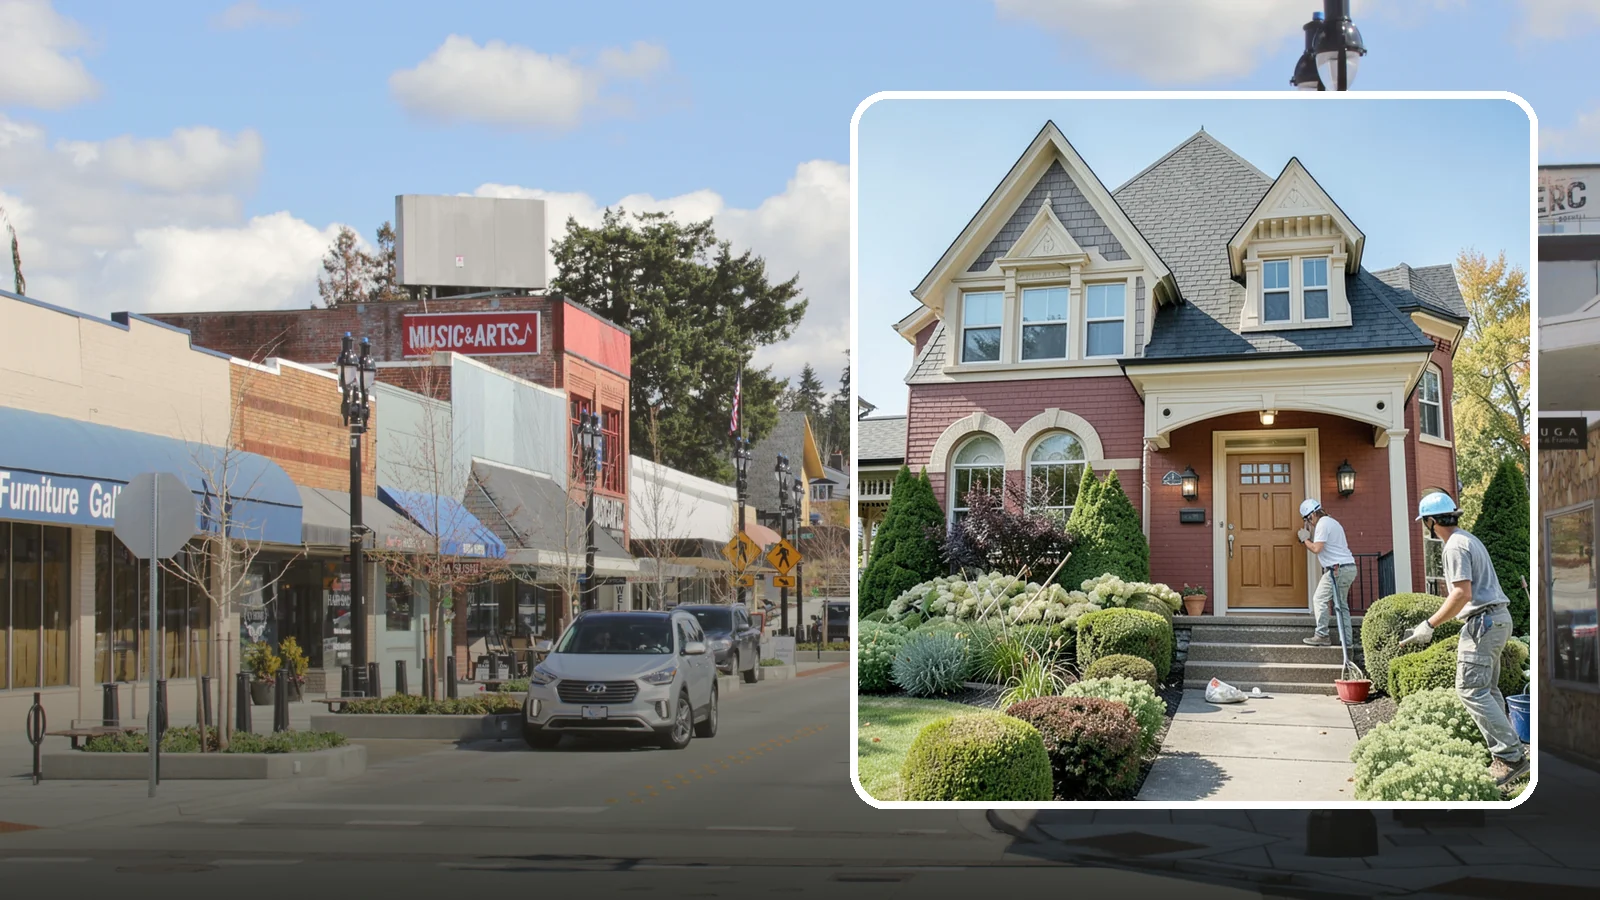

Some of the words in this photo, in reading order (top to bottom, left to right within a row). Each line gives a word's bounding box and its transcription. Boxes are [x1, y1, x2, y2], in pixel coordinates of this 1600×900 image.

[0, 471, 79, 515] Furniture
[89, 482, 122, 519] Gal
[453, 562, 479, 574] SUSHI
